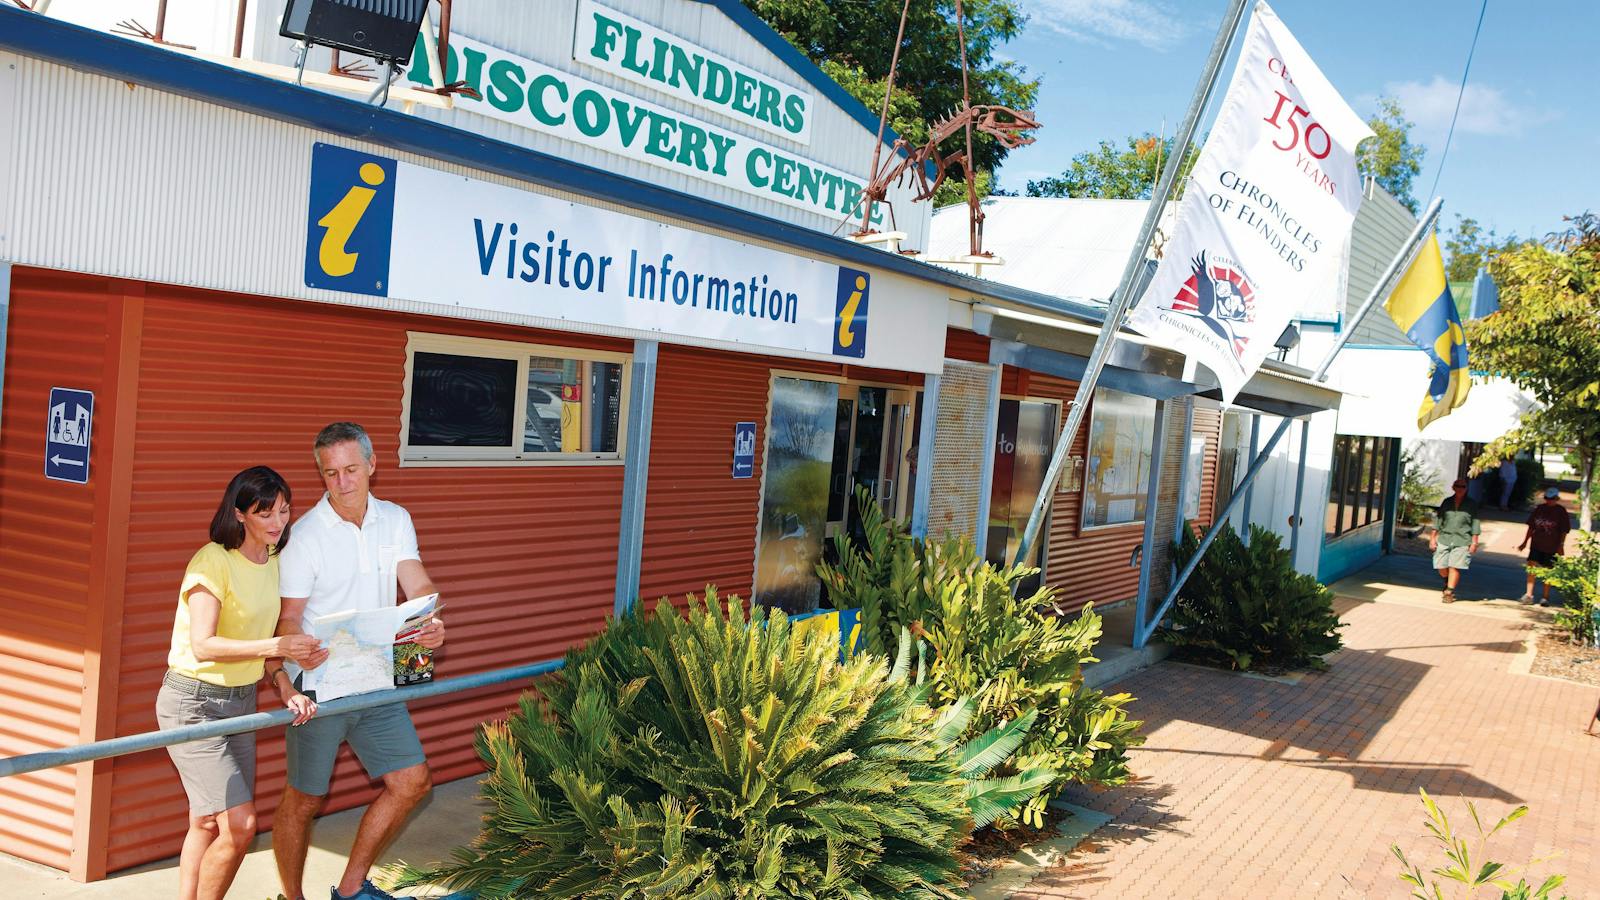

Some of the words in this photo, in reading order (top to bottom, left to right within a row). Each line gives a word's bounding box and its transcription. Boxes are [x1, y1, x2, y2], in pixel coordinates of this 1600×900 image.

[407, 31, 737, 177] DISCOVERY
[591, 12, 806, 134] FLINDERS
[1263, 90, 1332, 160] 150
[1219, 171, 1323, 254] CHRONICLES
[1296, 152, 1337, 196] YEARS
[474, 218, 613, 293] Visitor
[628, 249, 799, 324] Information
[1208, 193, 1235, 213] OF
[1236, 204, 1308, 273] FLINDERS
[998, 433, 1015, 454] to
